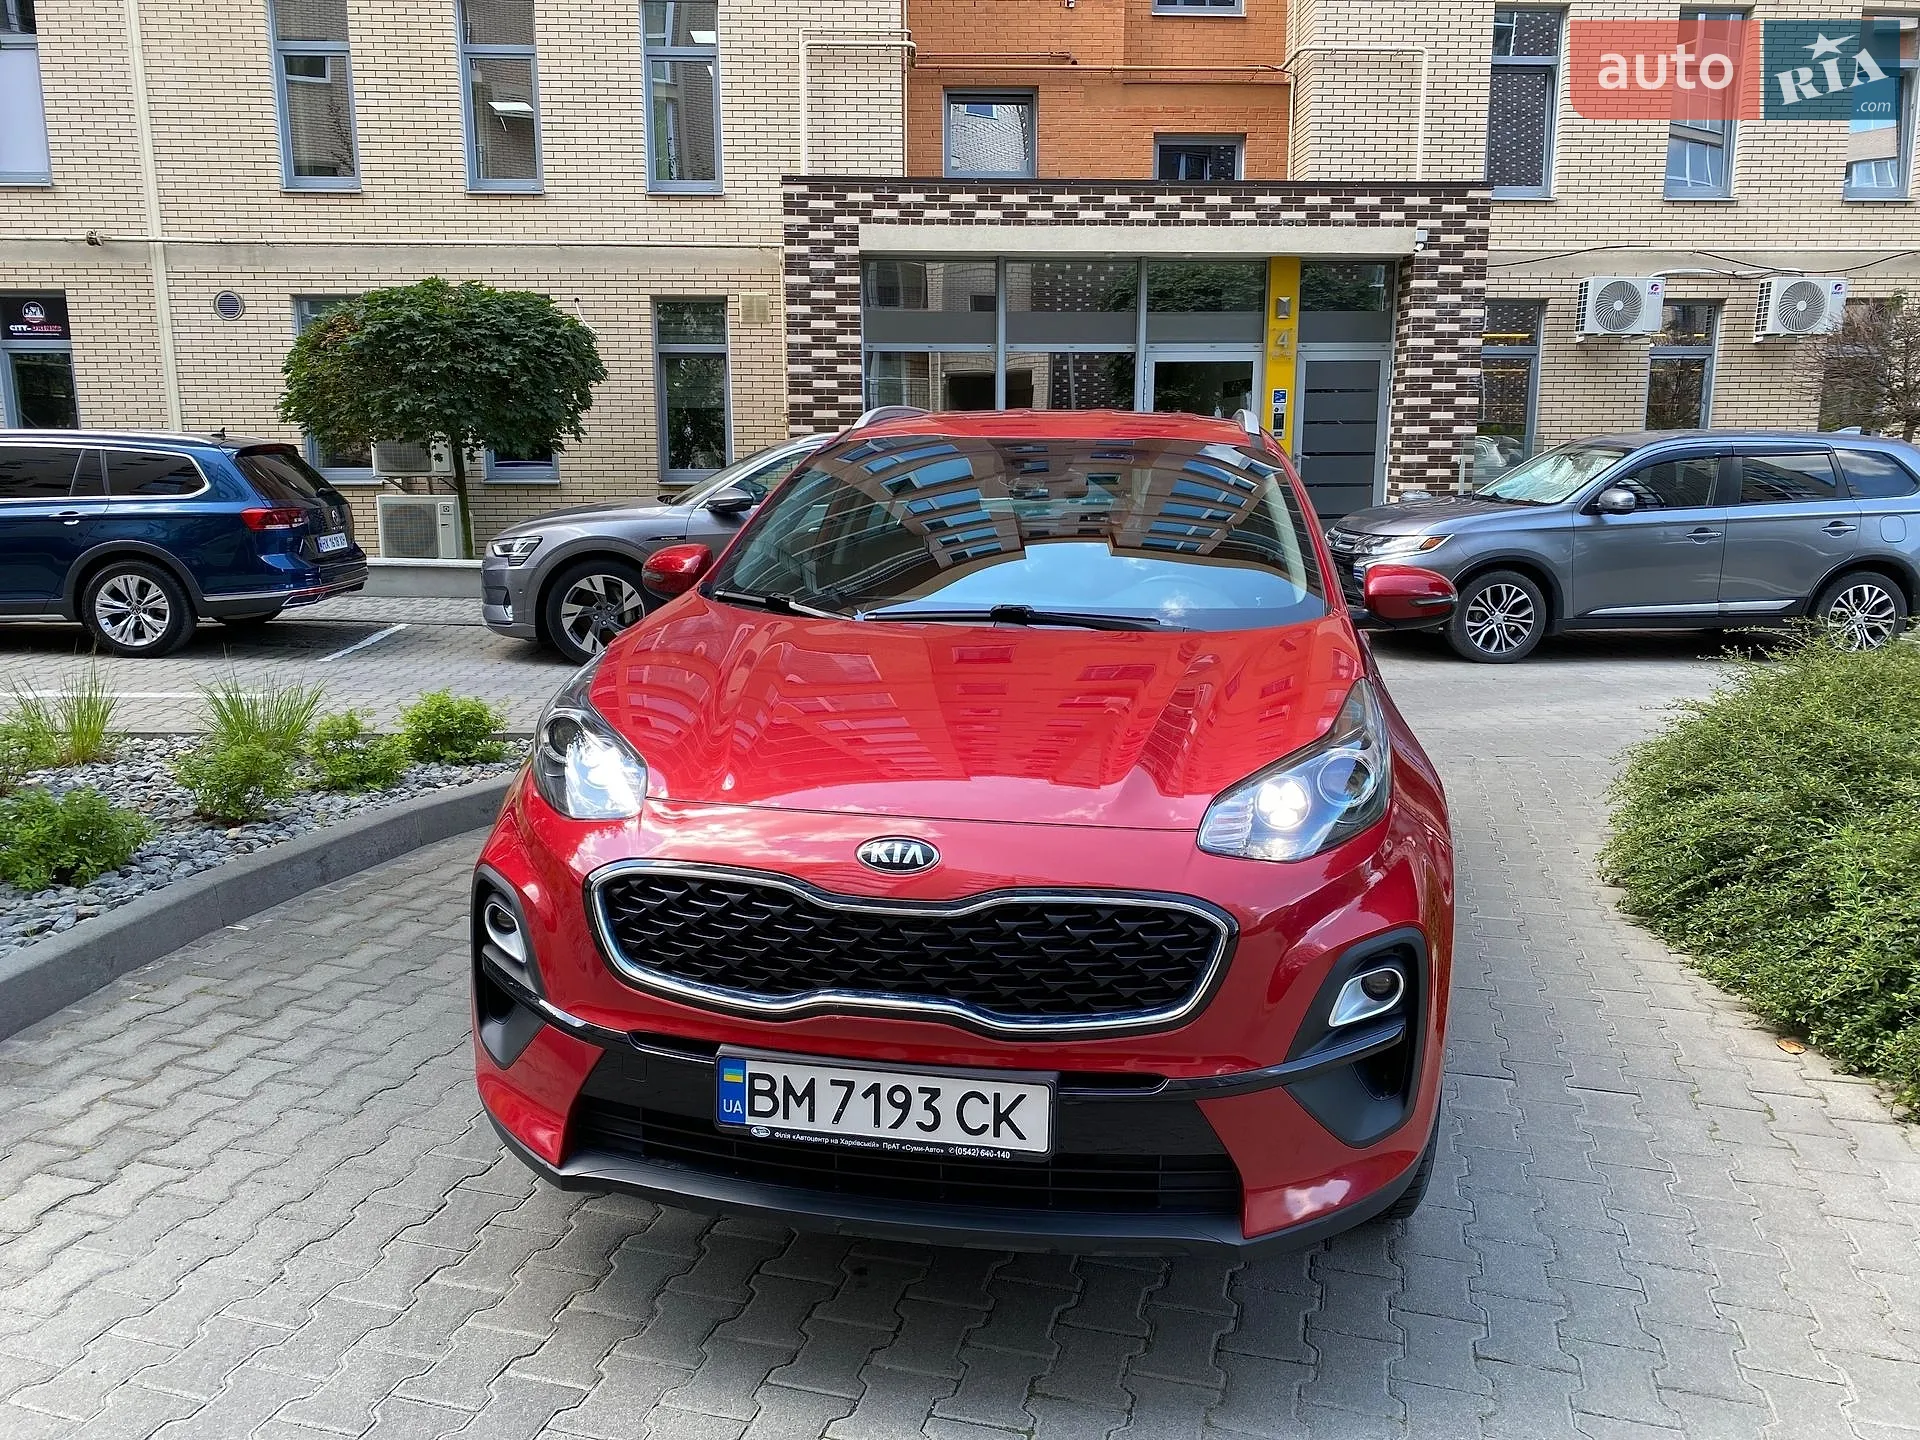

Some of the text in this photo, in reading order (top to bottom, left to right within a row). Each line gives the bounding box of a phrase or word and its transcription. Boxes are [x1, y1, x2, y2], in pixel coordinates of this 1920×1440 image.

[1277, 331, 1288, 348] 4
[869, 842, 925, 865] KIA
[723, 1099, 744, 1115] UA
[747, 1072, 1028, 1141] BM 7193 CK
